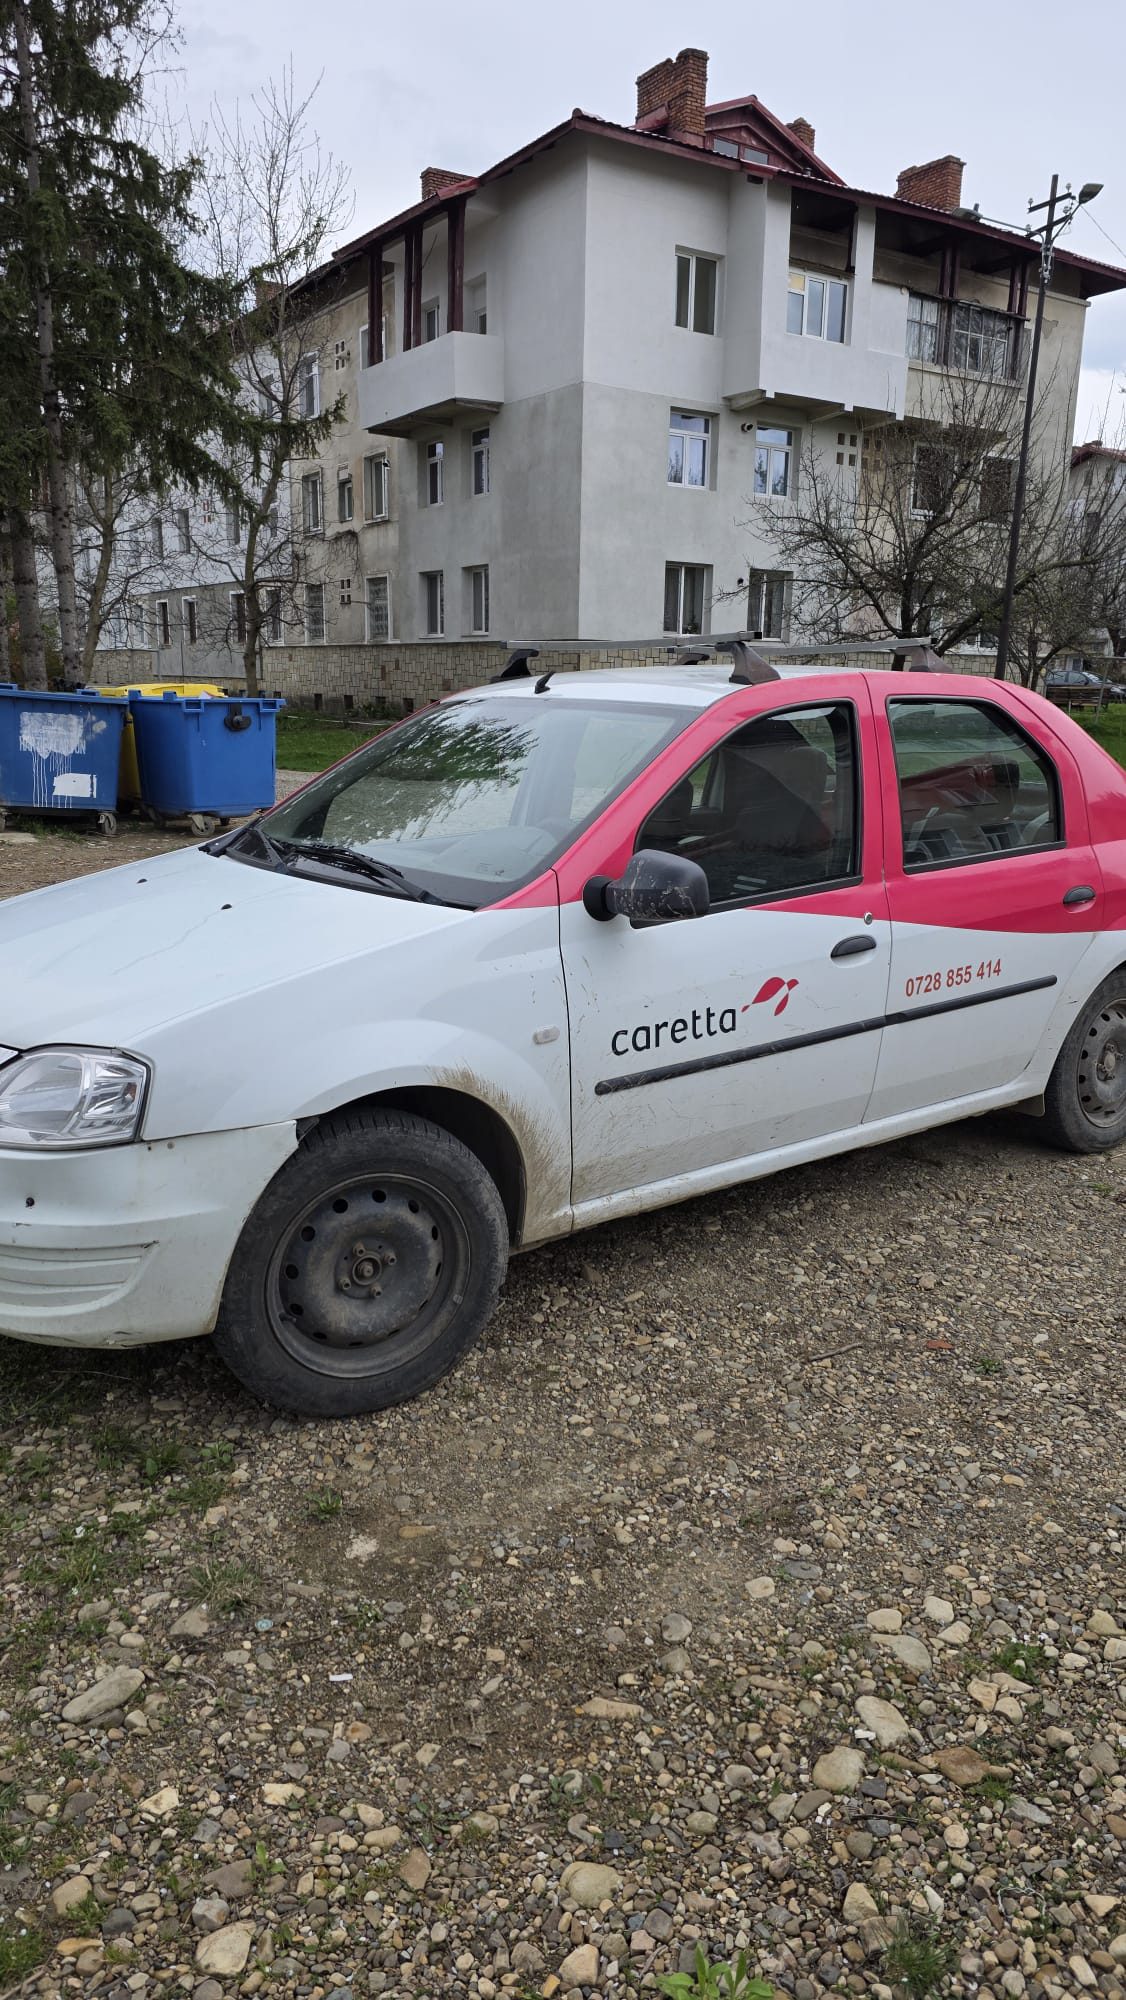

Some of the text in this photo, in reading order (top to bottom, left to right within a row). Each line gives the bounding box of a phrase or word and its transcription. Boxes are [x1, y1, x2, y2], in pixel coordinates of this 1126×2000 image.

[906, 958, 1001, 997] 0728 855 414
[611, 1007, 737, 1057] caretta
